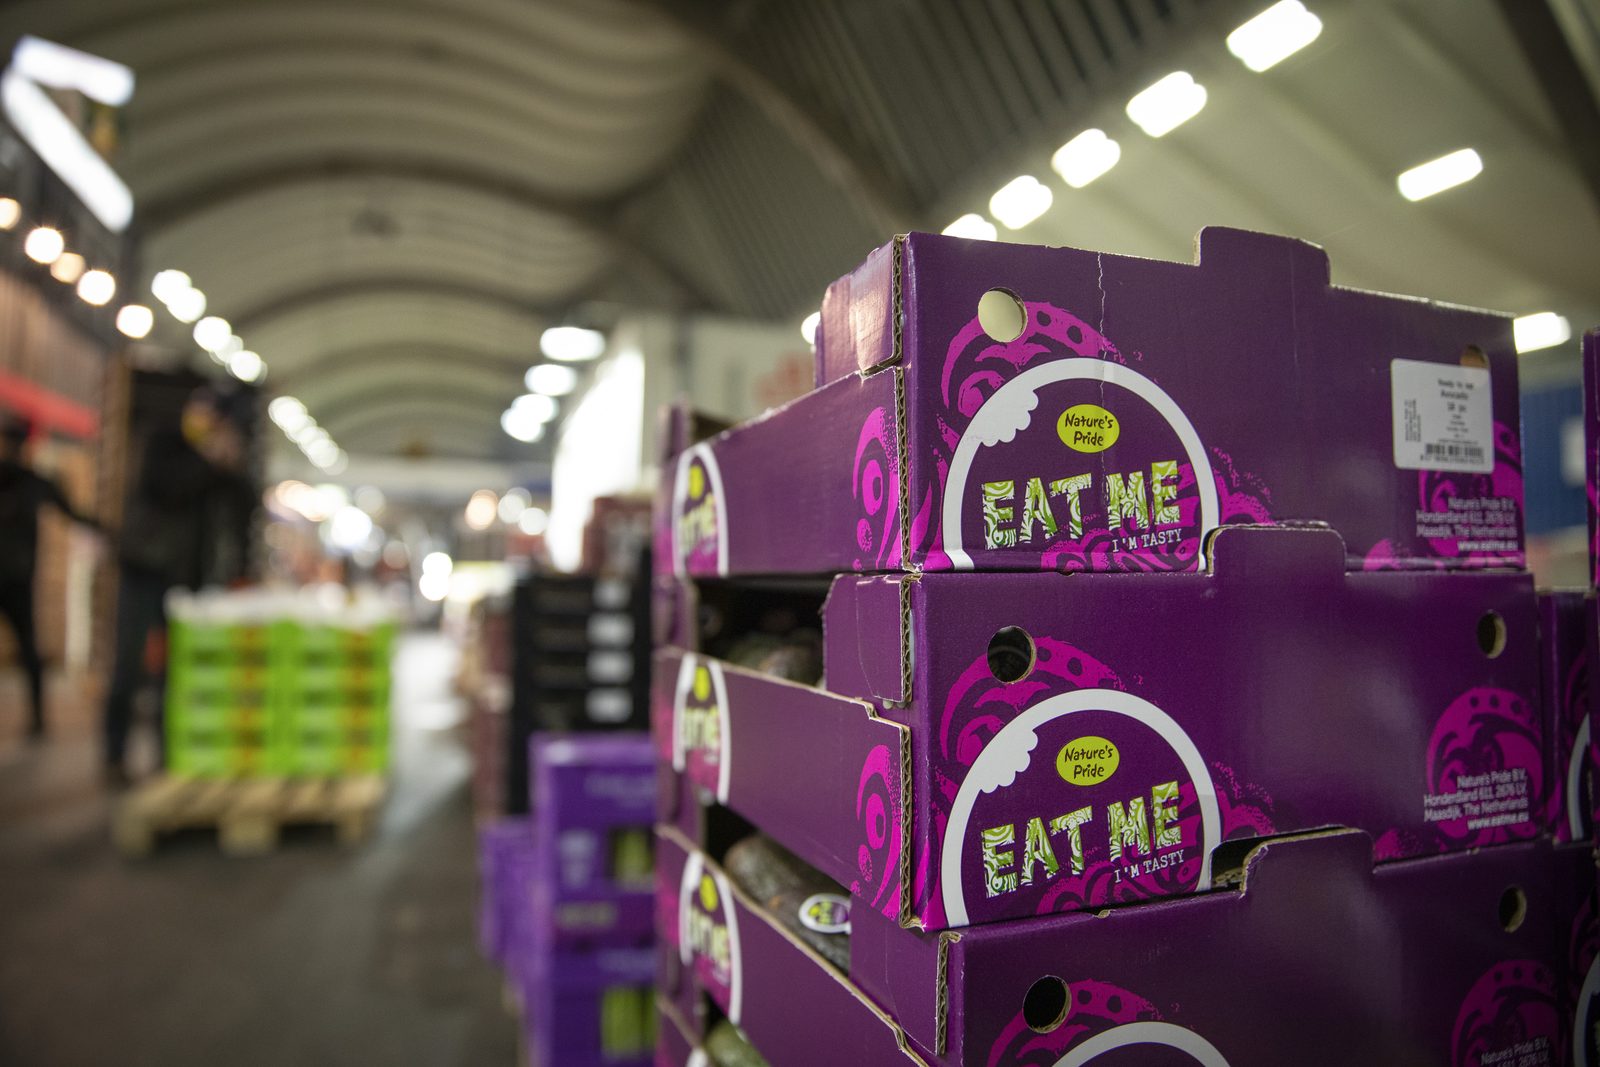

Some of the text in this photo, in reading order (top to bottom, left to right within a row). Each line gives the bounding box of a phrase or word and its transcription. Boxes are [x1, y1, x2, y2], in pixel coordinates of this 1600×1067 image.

[1064, 412, 1114, 430] Nature's
[1073, 430, 1105, 448] Pride
[983, 460, 1181, 550] EAT ME
[1112, 528, 1183, 553] I'M TASTY
[1064, 744, 1114, 763] Nature's
[1073, 764, 1105, 780] Pride
[1457, 774, 1491, 789] Nature's
[1491, 770, 1511, 784] Pride
[1464, 803, 1480, 816] The
[981, 780, 1183, 899] EAT ME
[1114, 849, 1185, 884] I'M TASTY
